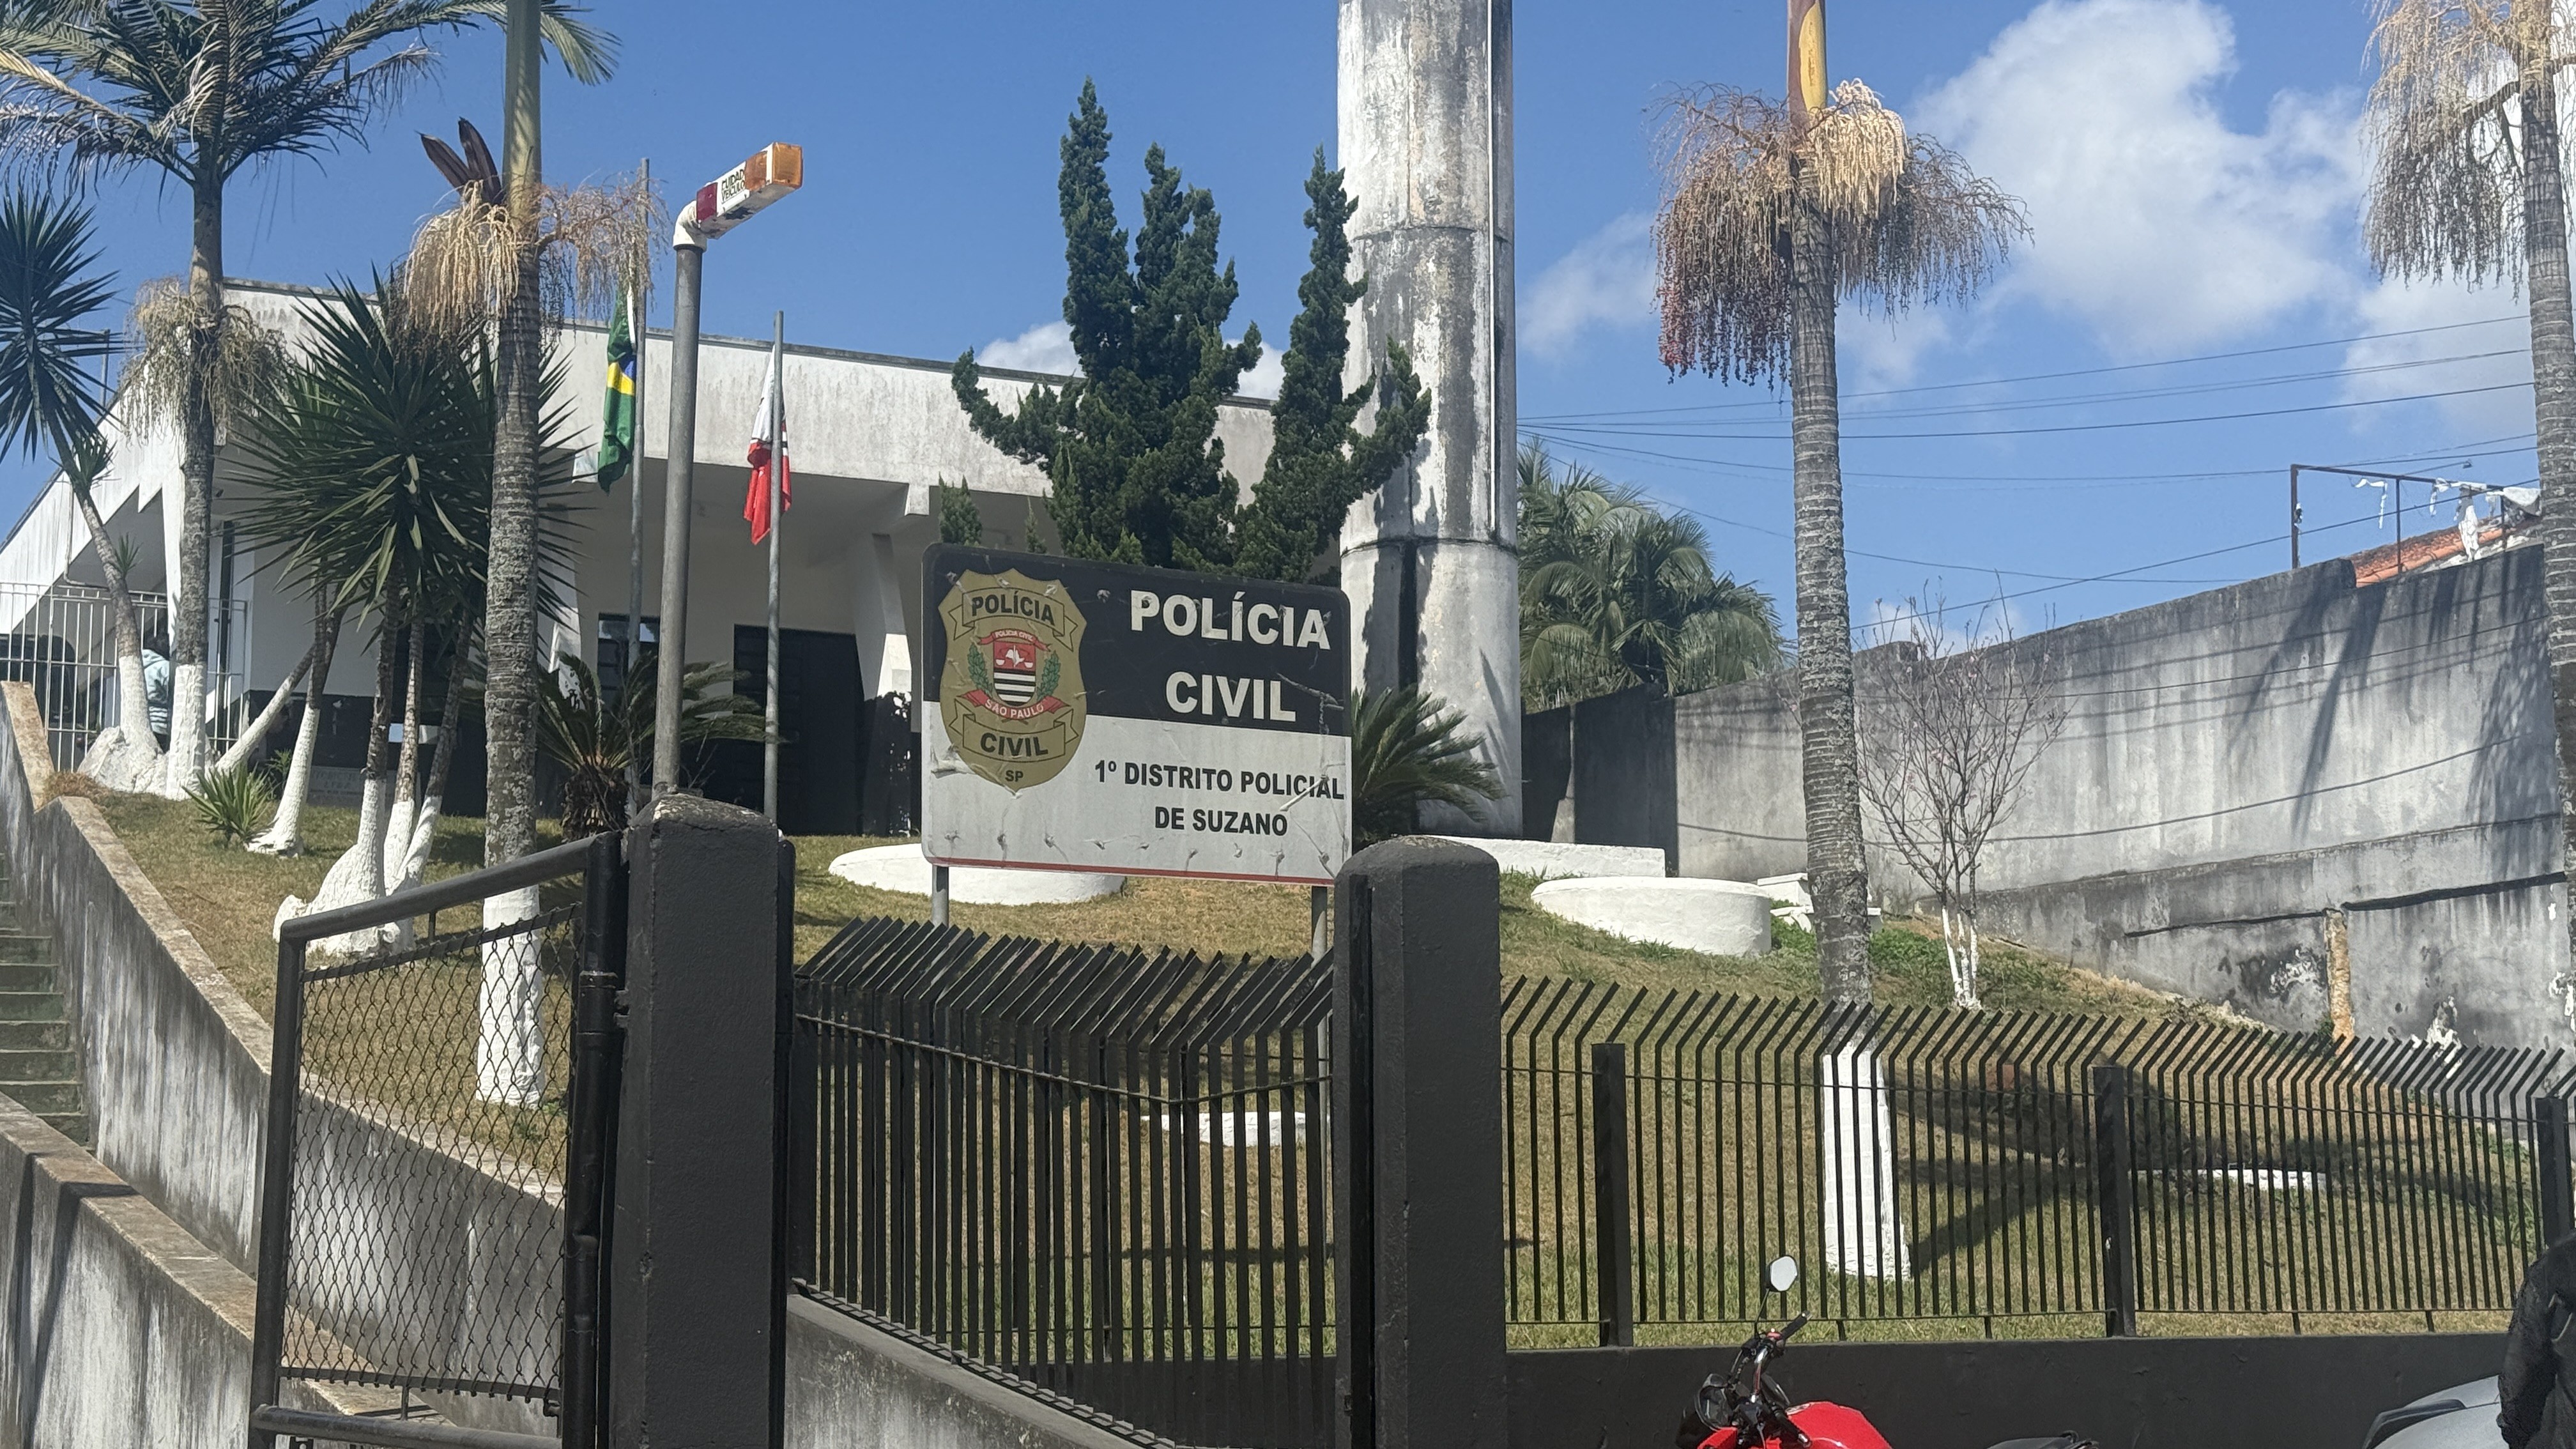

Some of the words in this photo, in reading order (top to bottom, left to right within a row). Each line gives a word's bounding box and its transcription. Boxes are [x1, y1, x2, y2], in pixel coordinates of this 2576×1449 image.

[722, 169, 745, 190] CUIDAD
[972, 590, 1055, 626] POLÍCIA
[1131, 590, 1331, 650] POLÍCIA
[1010, 703, 1044, 719] PAULO
[1166, 671, 1296, 722] CIVIL
[980, 732, 1048, 757] CIVIL
[1005, 770, 1023, 782] SP
[1124, 762, 1232, 792] DISTRITO
[1241, 771, 1344, 800] POLICIAL
[1155, 806, 1184, 829] DE
[1192, 809, 1287, 836] SUZANO
